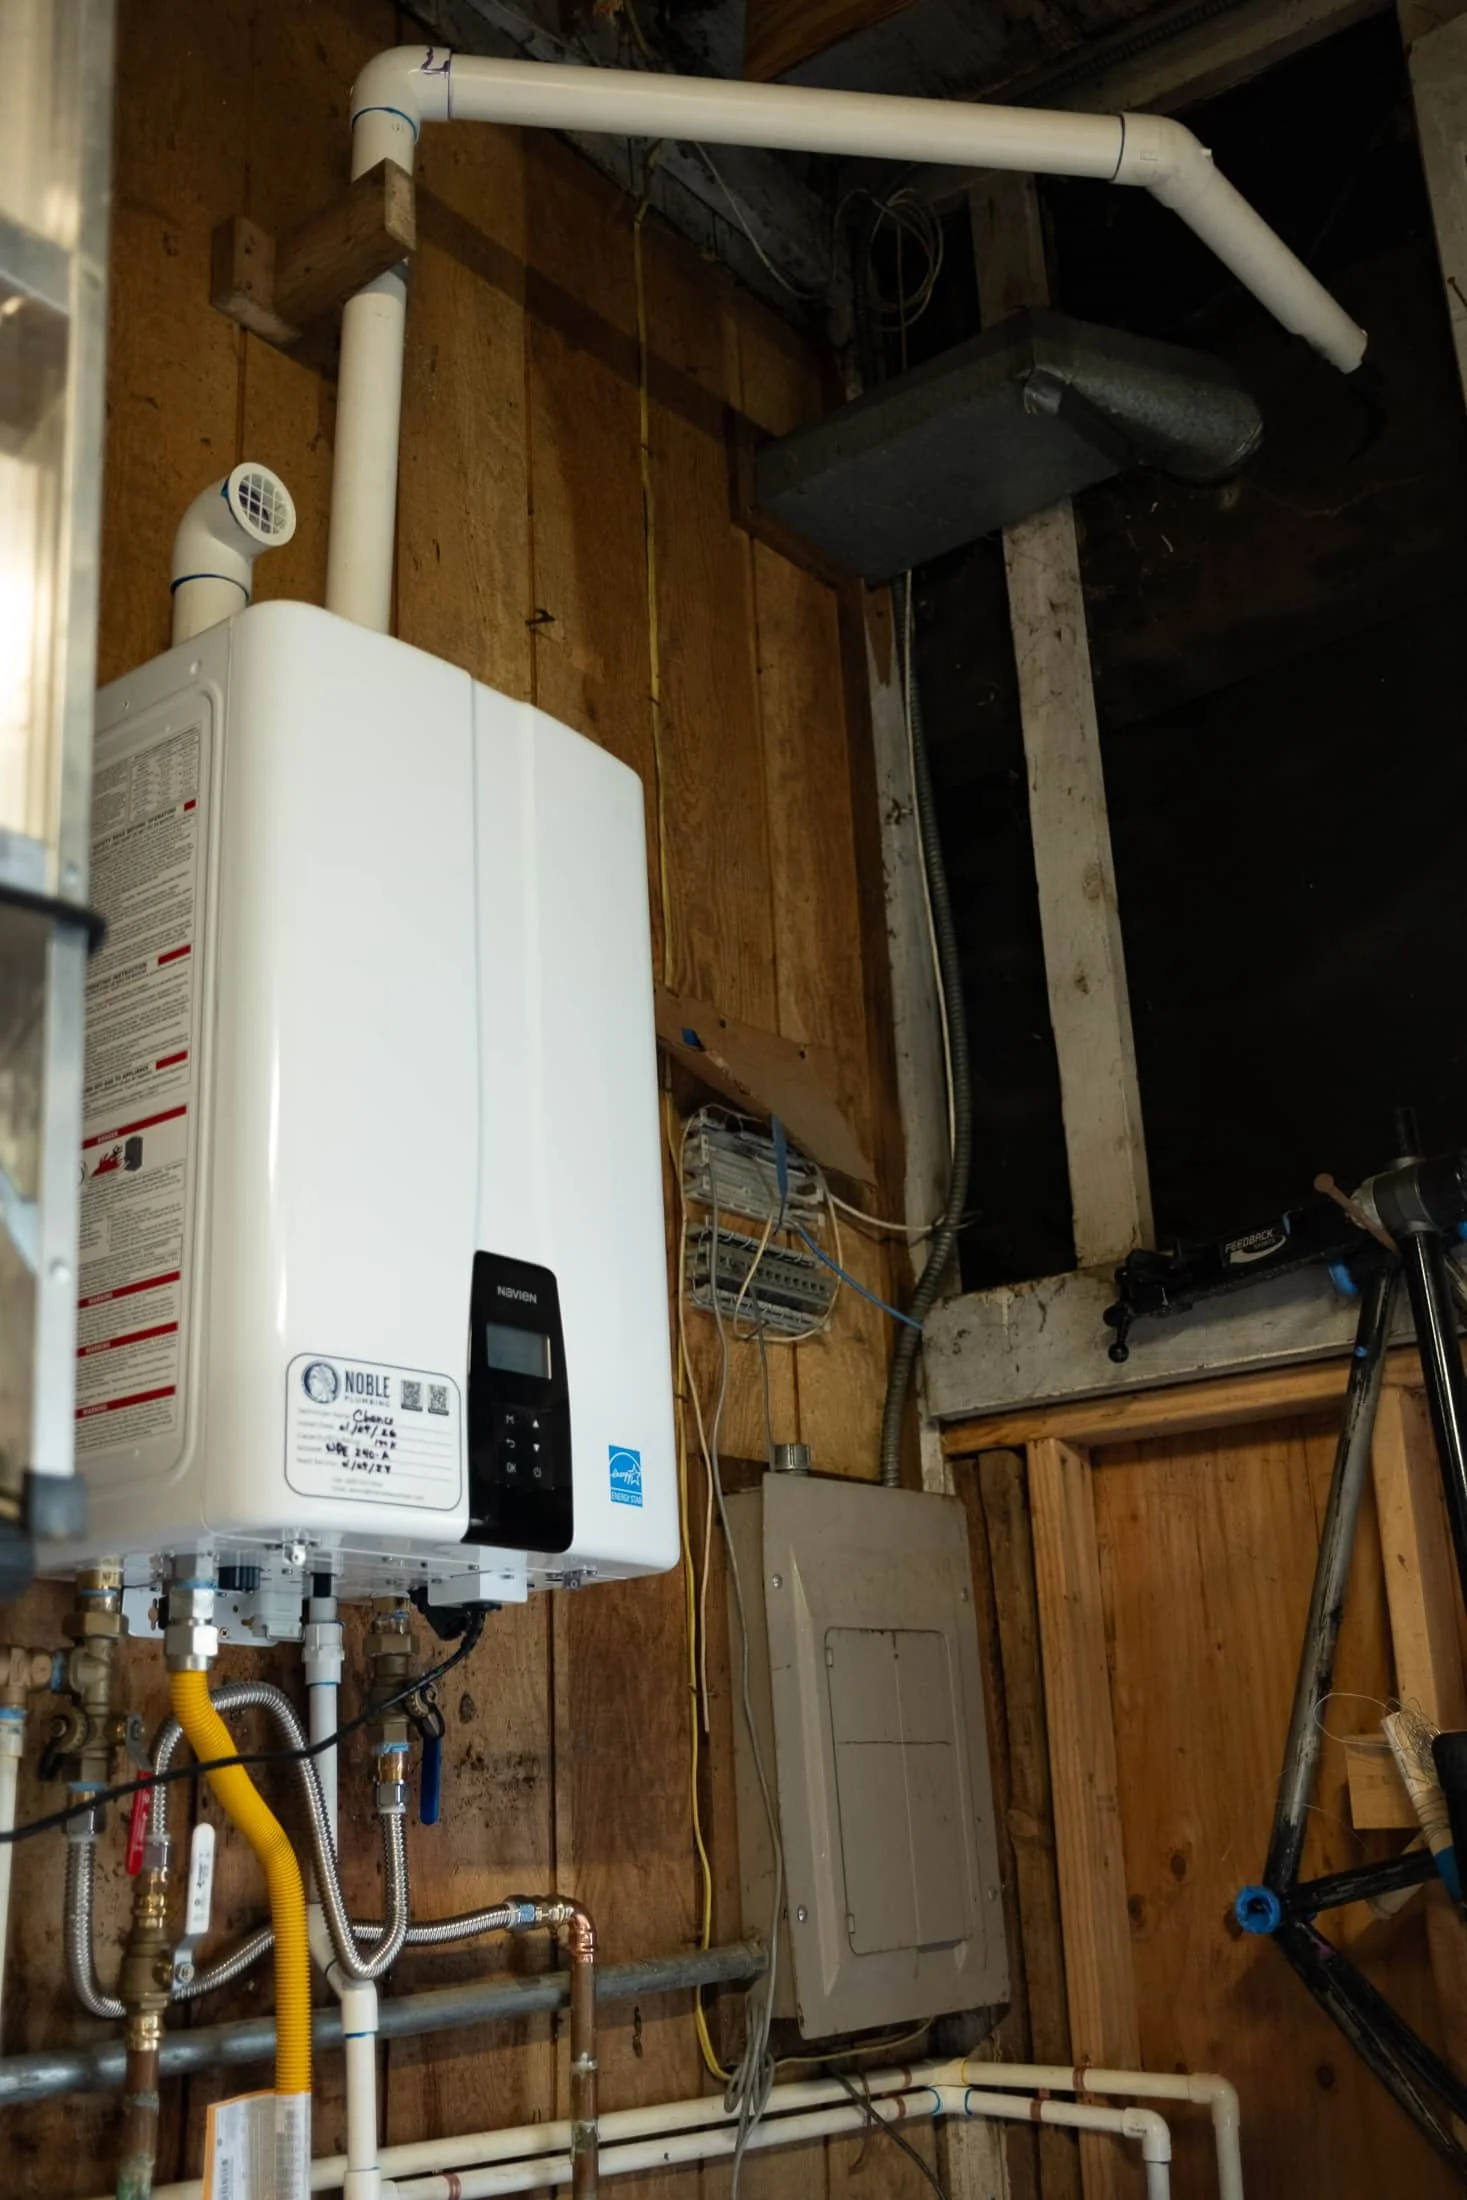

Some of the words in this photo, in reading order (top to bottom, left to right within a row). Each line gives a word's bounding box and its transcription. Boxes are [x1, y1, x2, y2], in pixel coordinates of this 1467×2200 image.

[1225, 1228, 1274, 1254] FEEDBACK
[345, 1370, 391, 1398] NOBLE
[506, 1461, 517, 1474] OK
